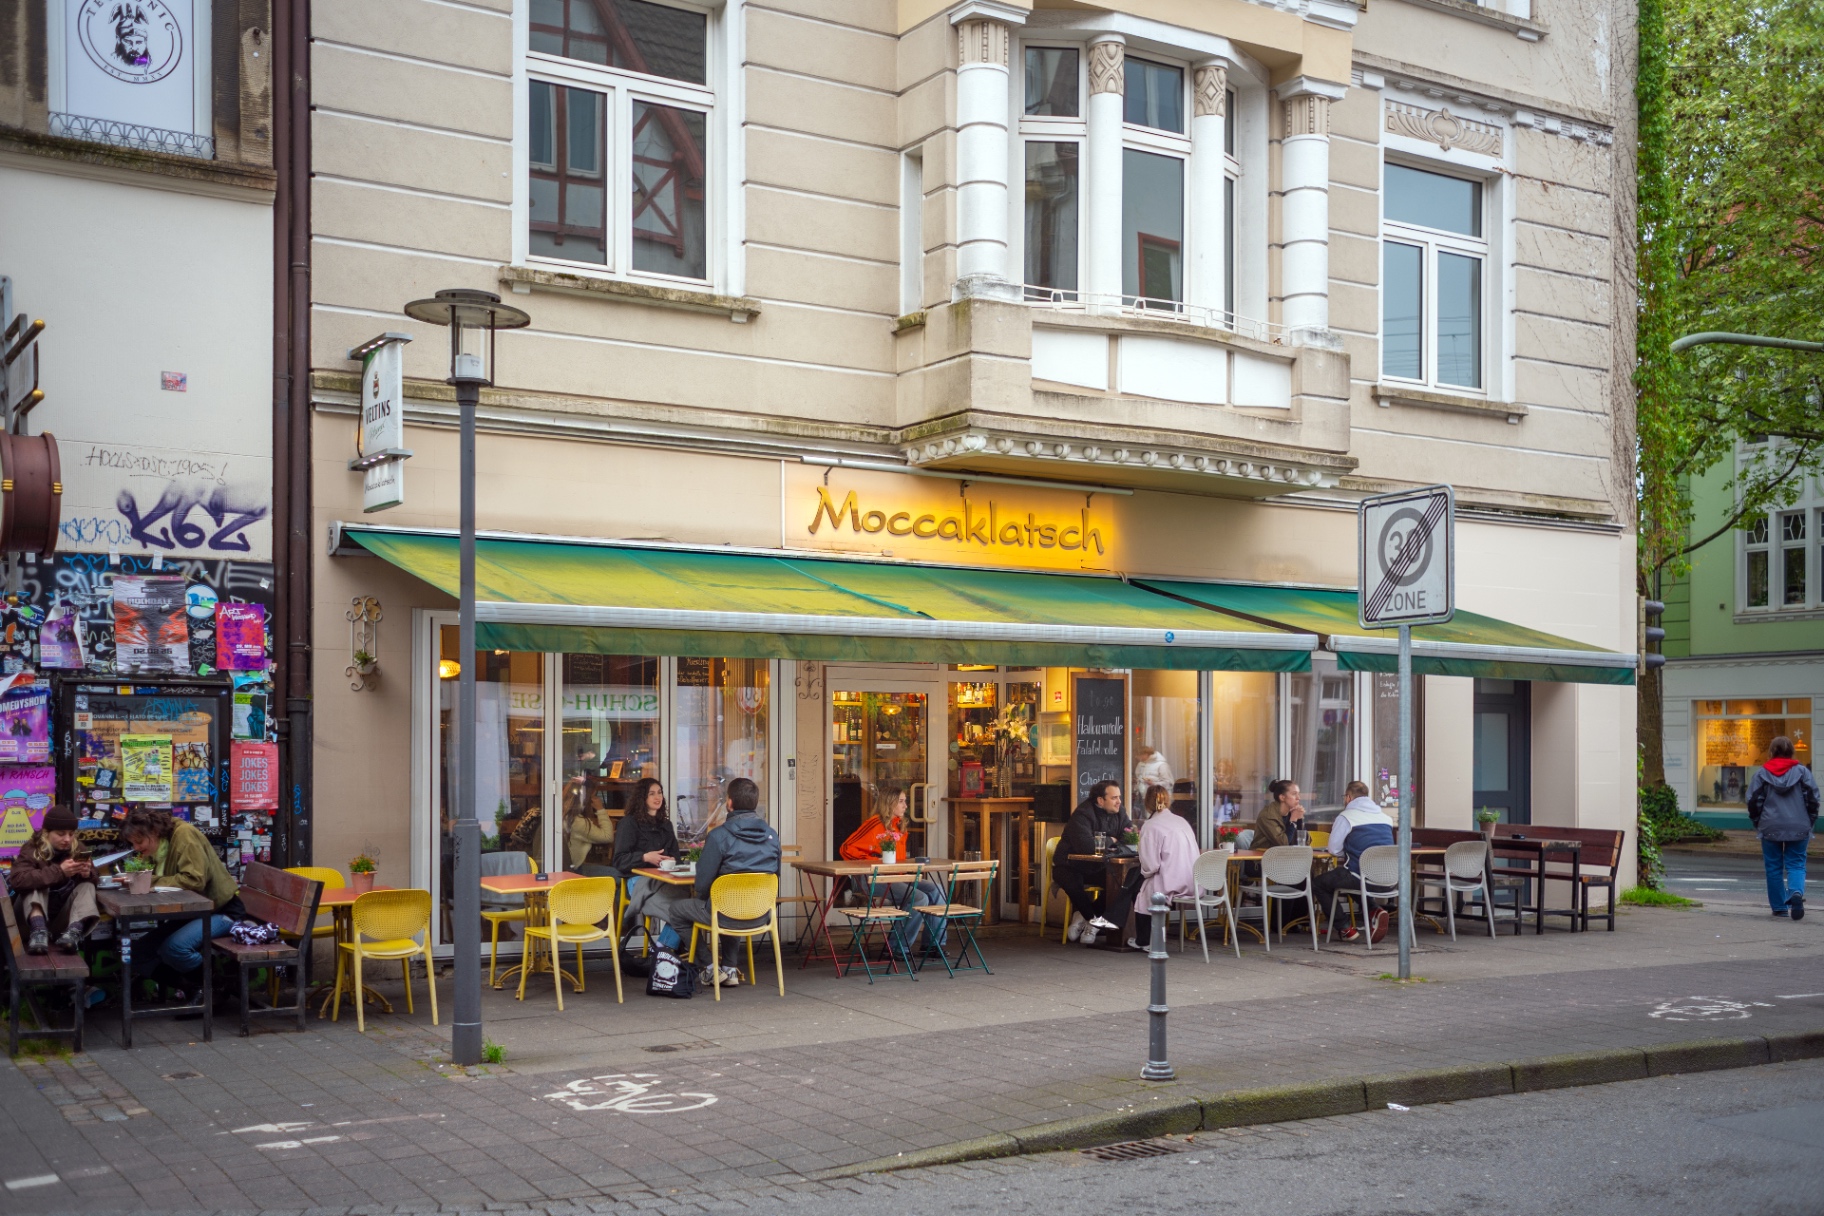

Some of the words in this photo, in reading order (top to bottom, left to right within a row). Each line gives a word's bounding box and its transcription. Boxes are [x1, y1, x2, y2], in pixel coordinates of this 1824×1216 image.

[85, 0, 175, 32] TENIC
[365, 399, 391, 425] VELTINS
[807, 485, 1105, 555] Moccaklatsch
[1389, 527, 1421, 566] 30
[1384, 590, 1427, 613] ZONE
[0, 694, 47, 712] OMEDYSHOW
[240, 757, 268, 769] JOKES
[9, 769, 50, 780] RAMSCH
[240, 769, 268, 781] JOKES
[240, 781, 269, 793] JOKES
